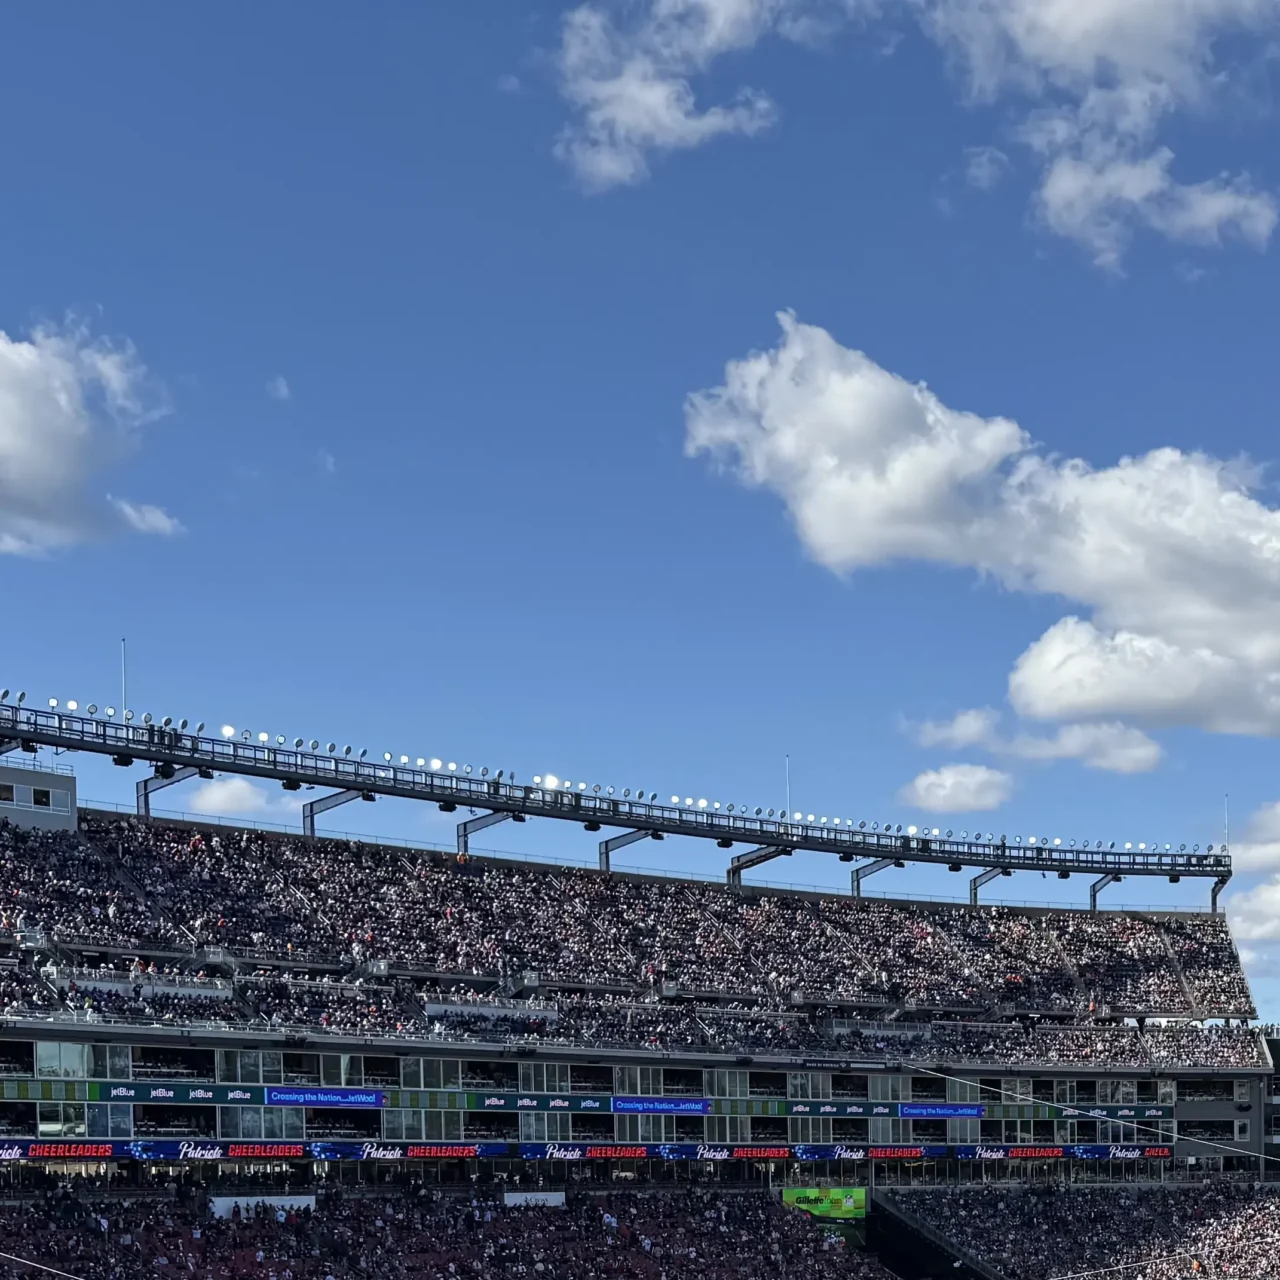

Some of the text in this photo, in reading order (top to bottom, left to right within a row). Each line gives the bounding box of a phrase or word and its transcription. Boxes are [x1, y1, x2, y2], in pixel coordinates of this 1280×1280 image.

[111, 1086, 251, 1101] jetBlue jetBlue jetBlue jetBlue
[272, 1091, 302, 1103] Crossing
[305, 1092, 316, 1101] the
[485, 1097, 600, 1110] jetBlue jetBlue jetBlue jetBlue
[28, 1144, 113, 1157] CHEERLEADERS
[179, 1141, 303, 1159] Patriots CHEERLEADERS
[362, 1141, 476, 1159] Patriots CHEERLEADERS
[546, 1143, 647, 1159] Patriots CHEERLEADERS
[697, 1143, 789, 1159] Patriots CHEERLEADERS
[834, 1144, 921, 1160] Patriots CHEERLEADERS
[975, 1145, 1063, 1160] Patriots CHEERLEADERS
[1110, 1144, 1141, 1159] Patriots
